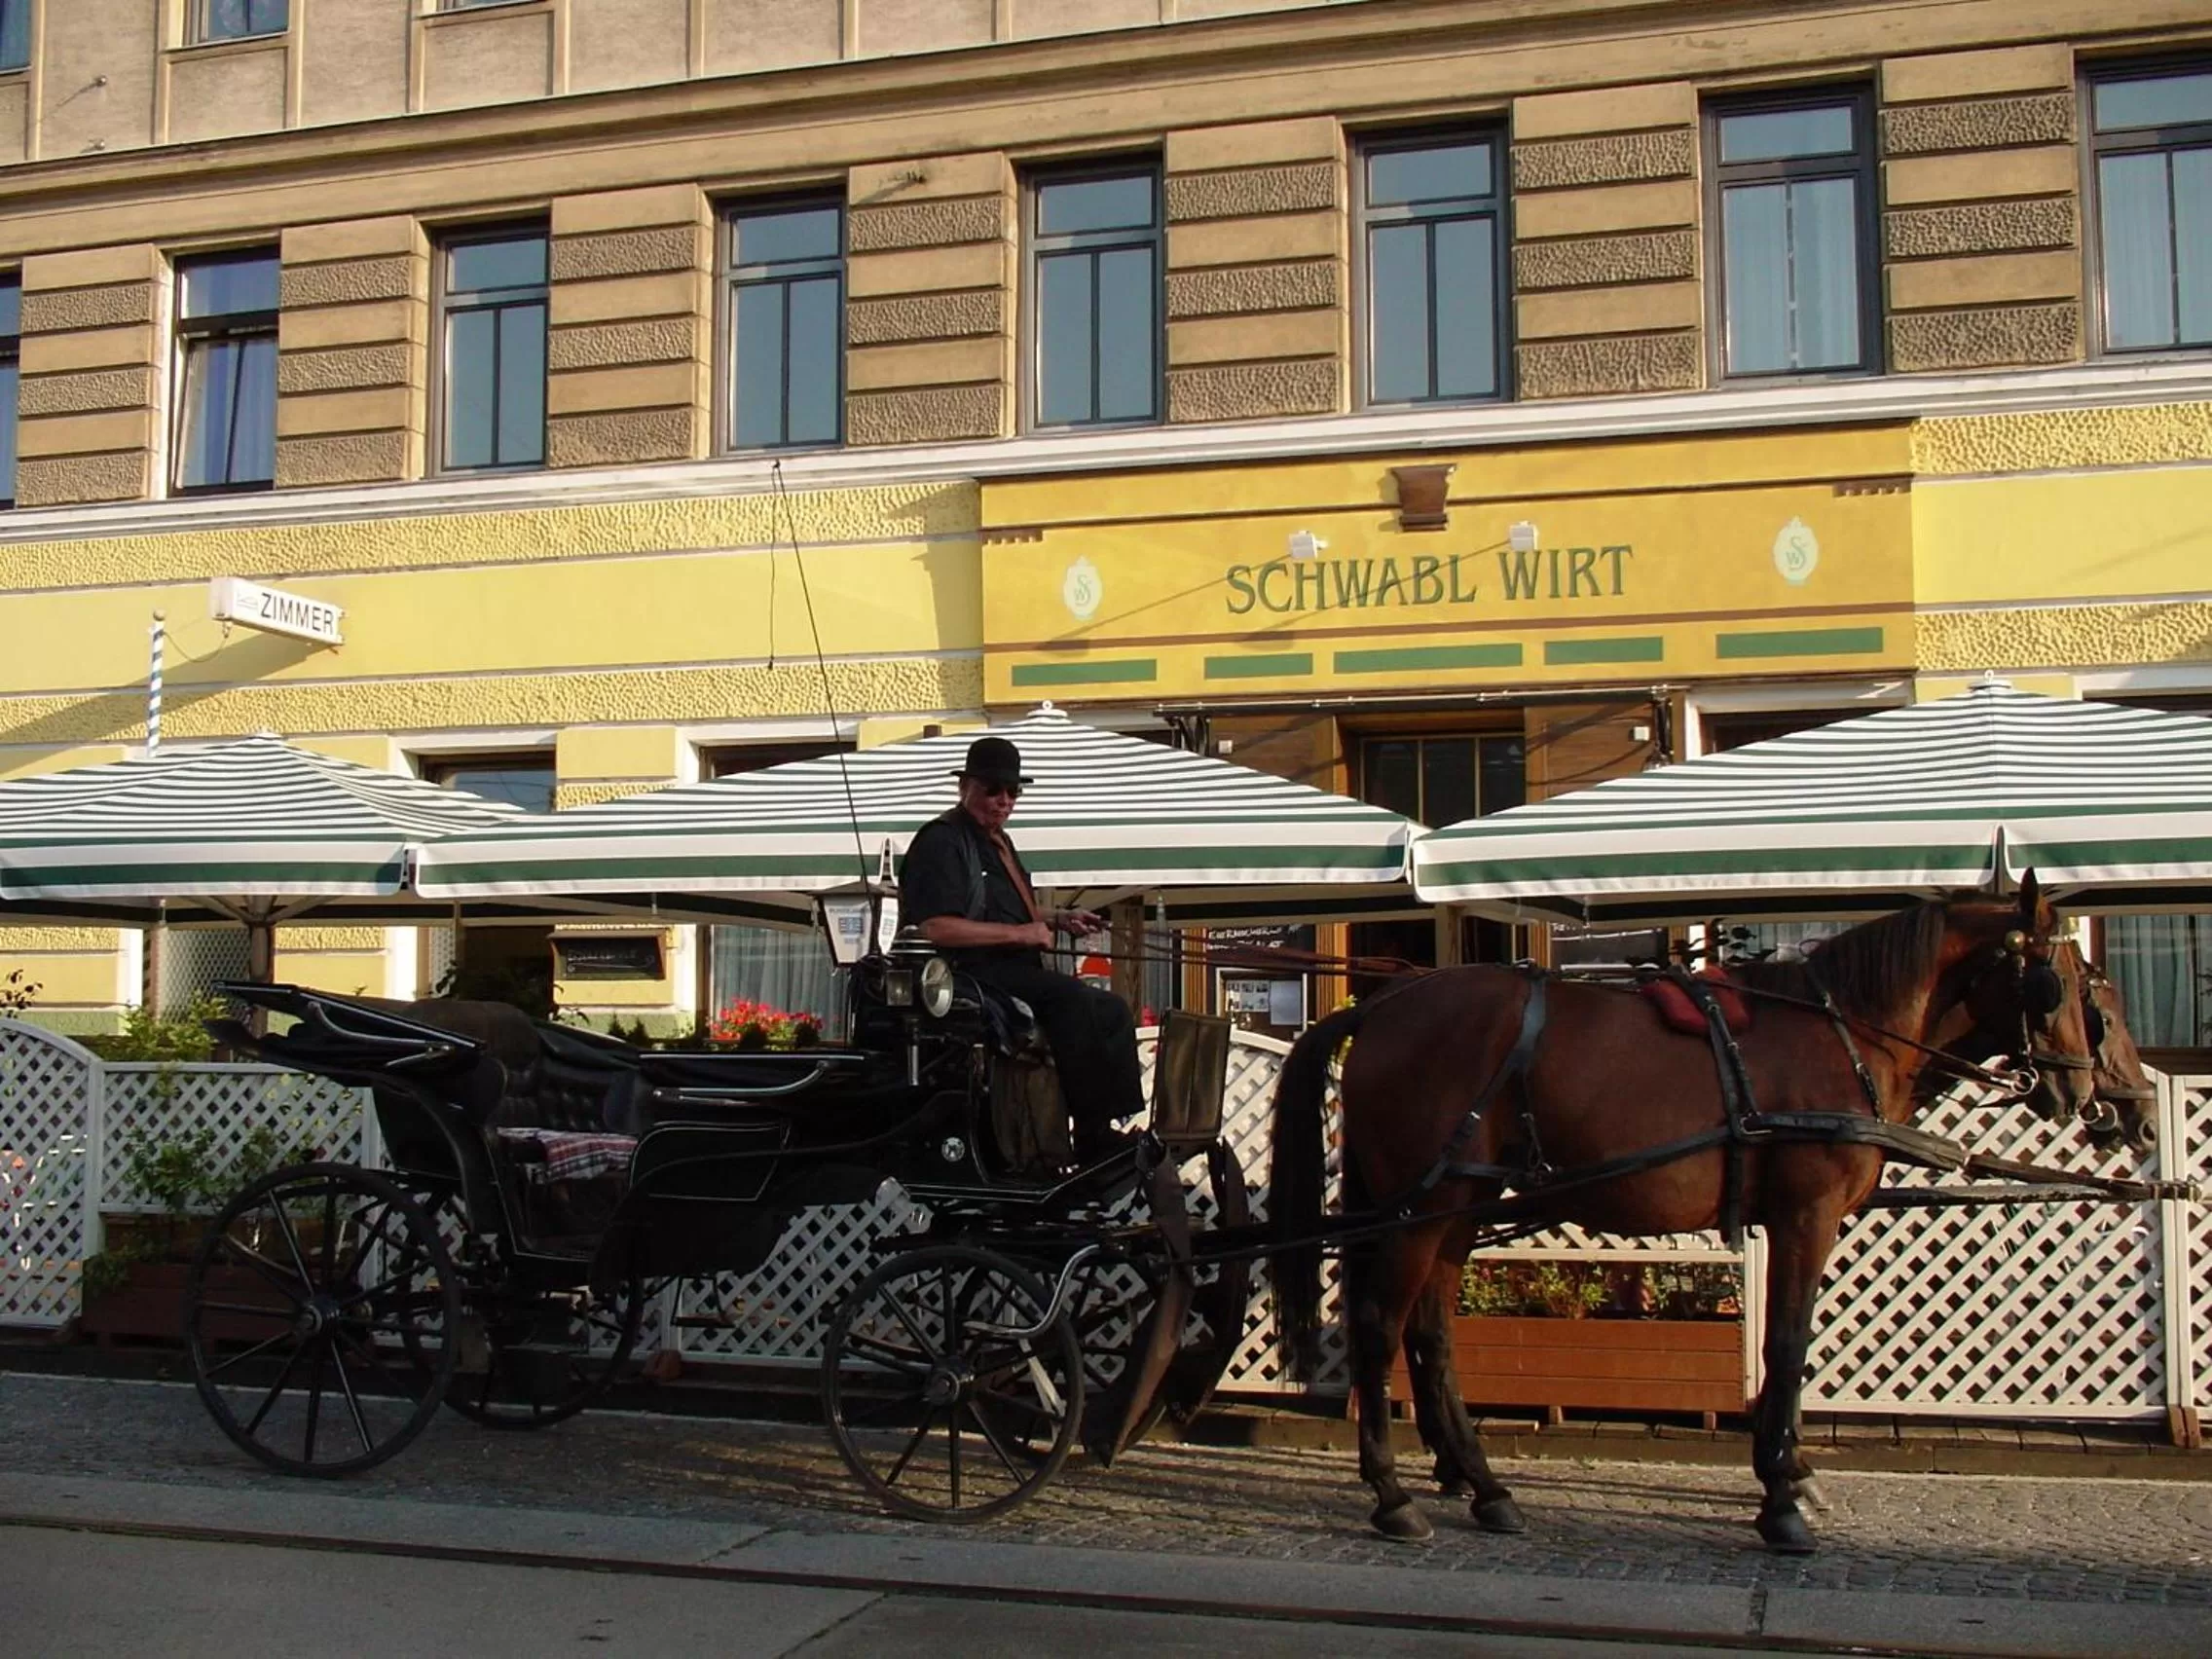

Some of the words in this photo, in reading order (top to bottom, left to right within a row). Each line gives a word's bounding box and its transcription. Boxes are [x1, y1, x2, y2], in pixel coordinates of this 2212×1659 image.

[1226, 554, 1477, 614] SCHWABL
[1497, 545, 1634, 600] WIRT
[260, 592, 334, 634] ZIMMER
